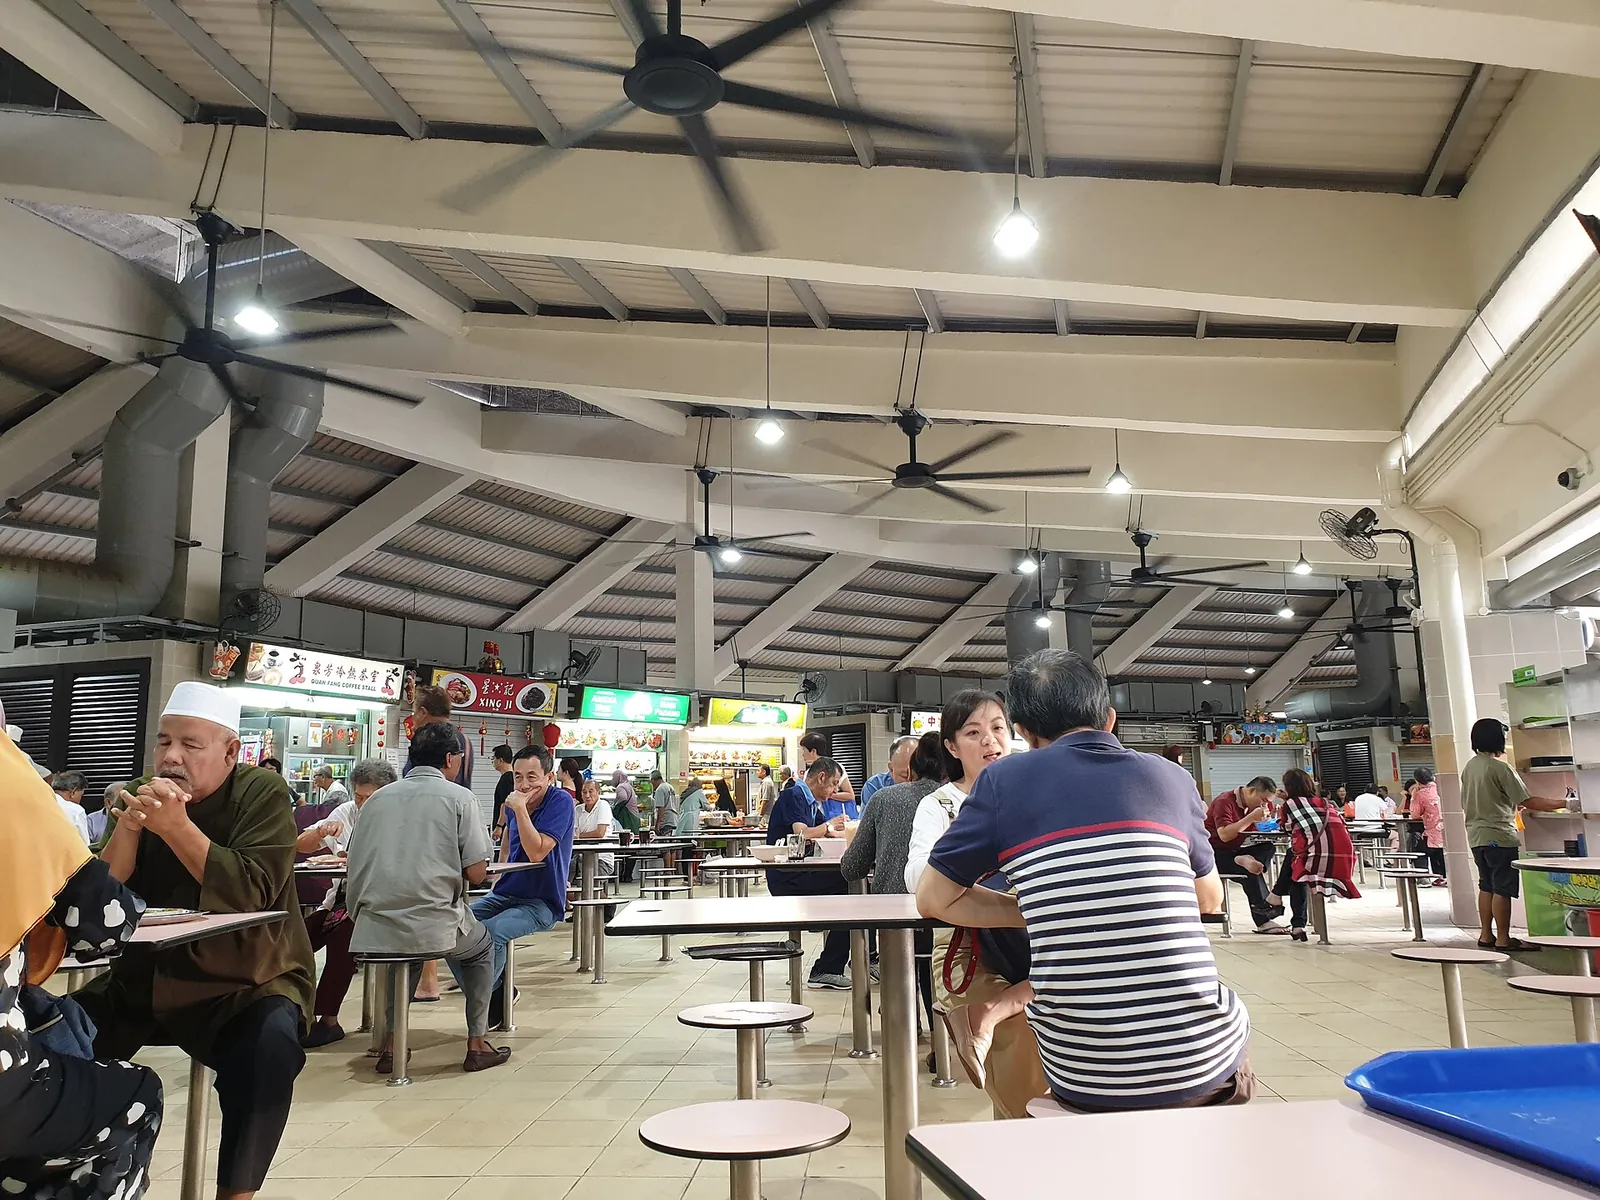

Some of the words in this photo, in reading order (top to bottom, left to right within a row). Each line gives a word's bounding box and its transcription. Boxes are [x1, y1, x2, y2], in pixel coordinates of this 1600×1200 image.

[327, 680, 341, 688] FANG
[479, 697, 502, 708] XING
[504, 699, 513, 710] JI
